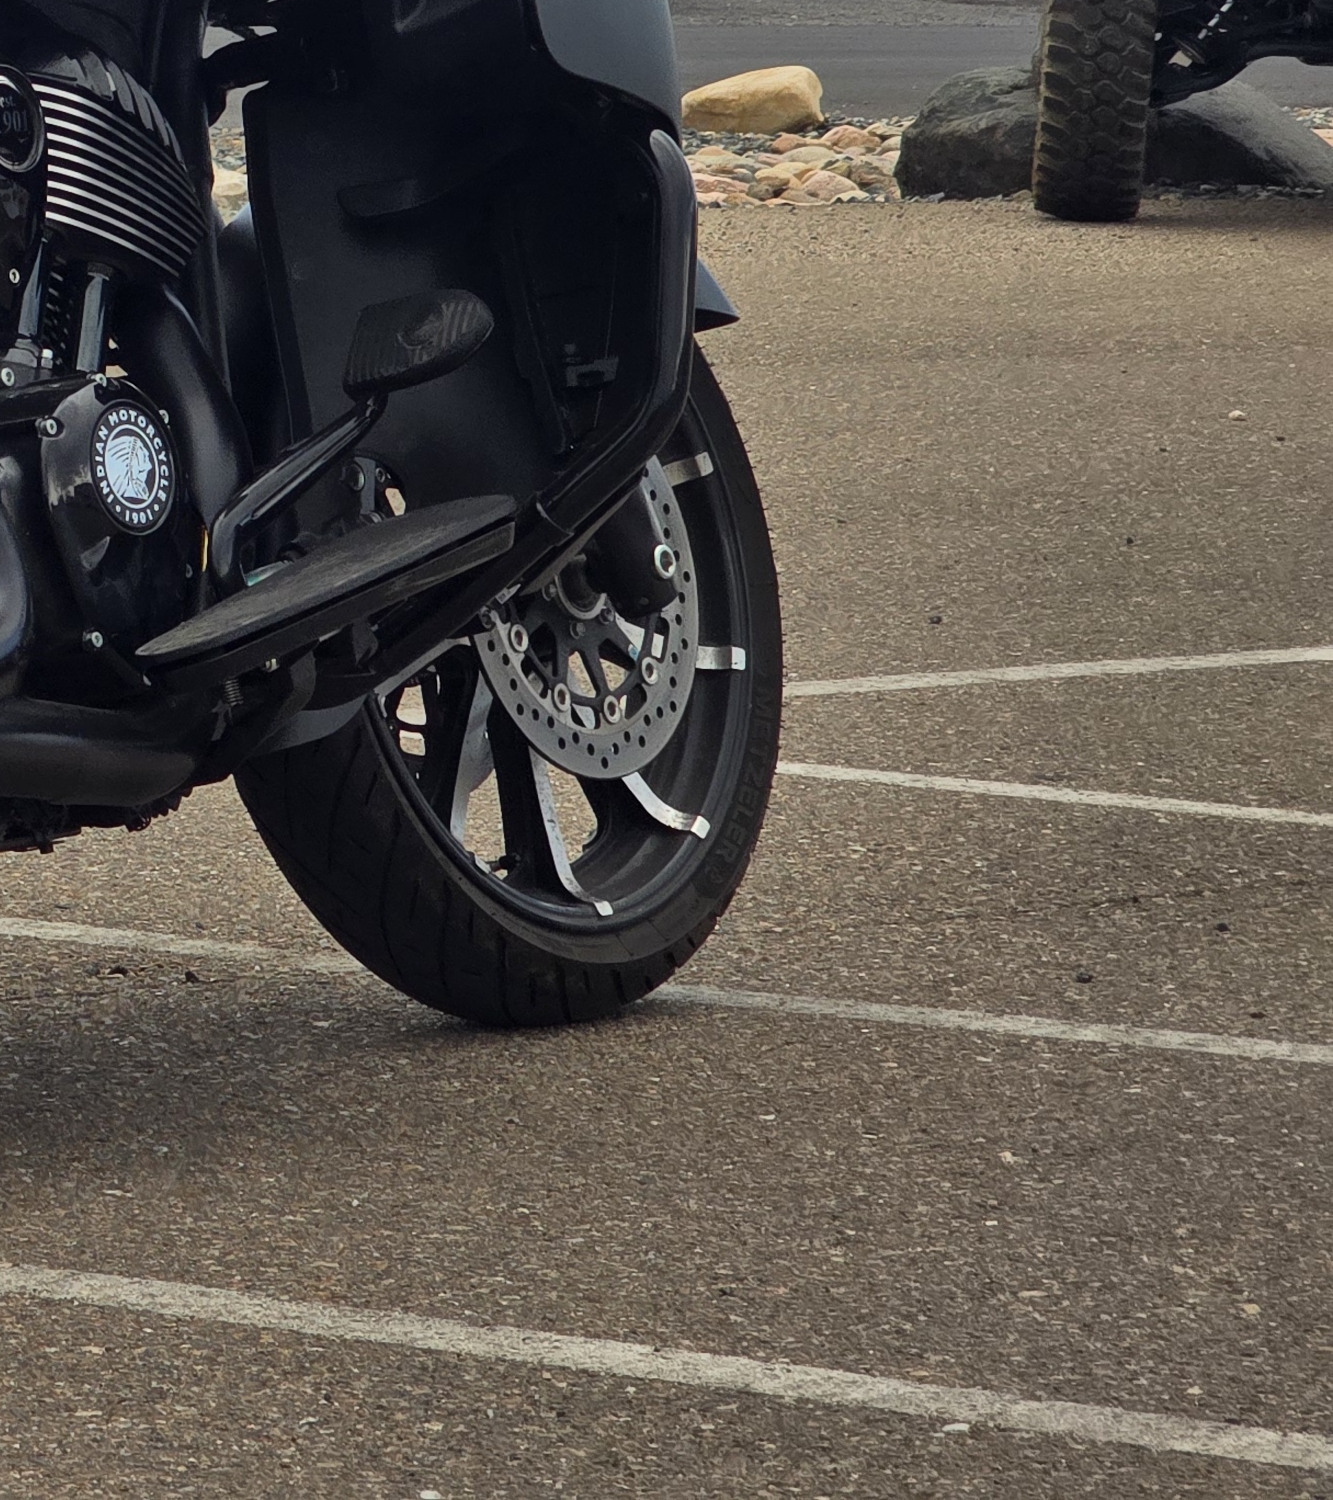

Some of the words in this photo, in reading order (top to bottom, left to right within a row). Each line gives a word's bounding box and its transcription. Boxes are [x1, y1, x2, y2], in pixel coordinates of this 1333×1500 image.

[95, 426, 114, 506] INDIAN
[108, 409, 169, 503] MOTORCYCLE
[124, 508, 154, 524] 1901
